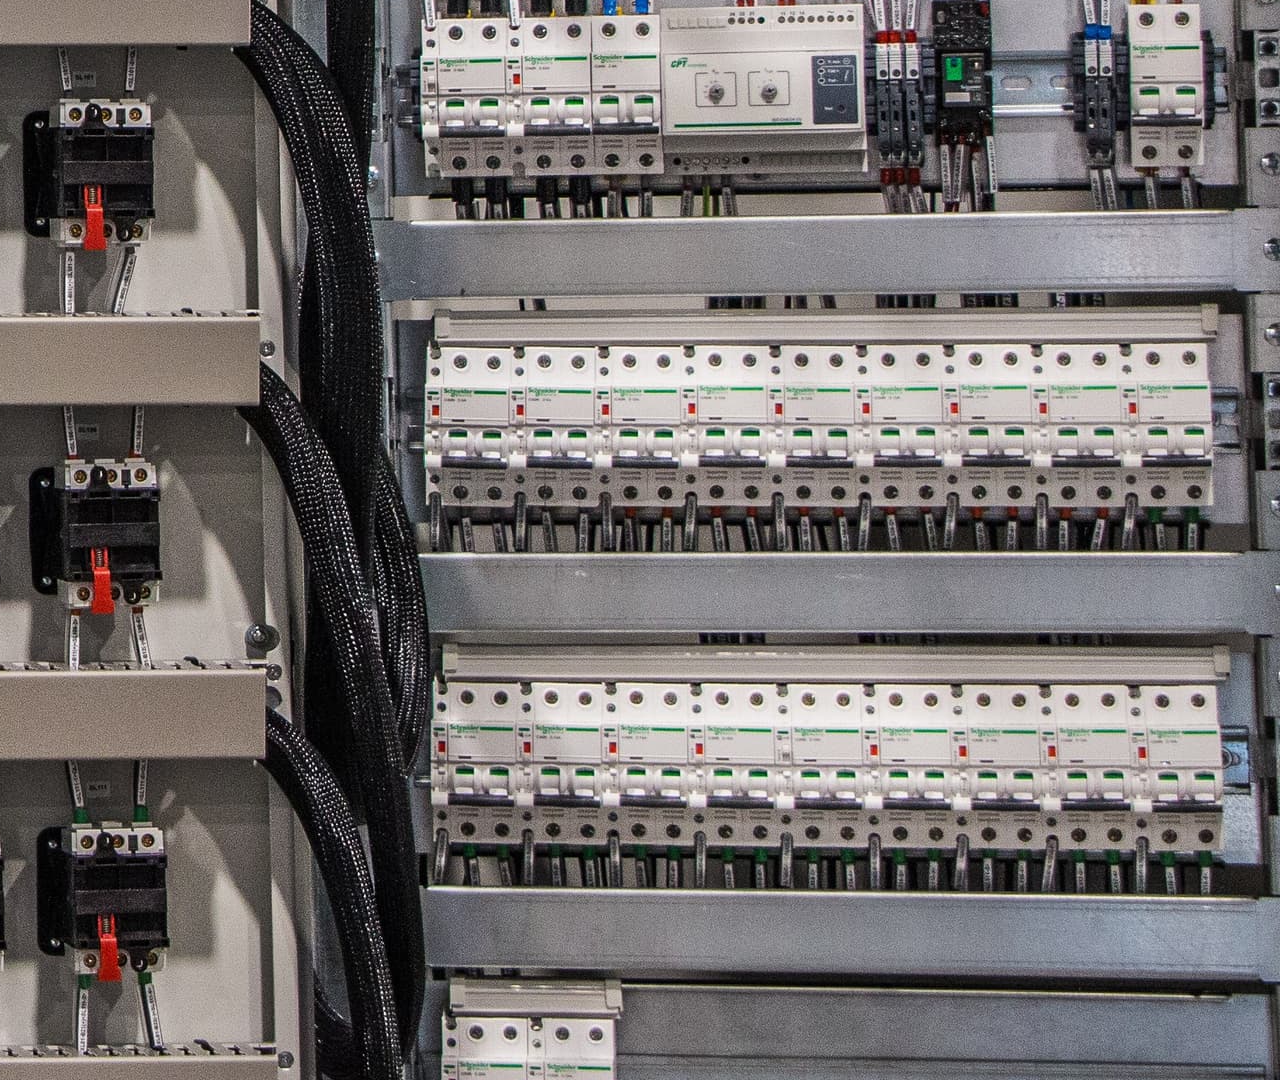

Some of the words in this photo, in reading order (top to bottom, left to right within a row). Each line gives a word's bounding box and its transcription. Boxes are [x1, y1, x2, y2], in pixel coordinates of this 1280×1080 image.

[1132, 45, 1164, 55] Schneider
[439, 58, 468, 67] Schneider
[524, 55, 553, 64] Schneider
[593, 54, 623, 63] Schneider
